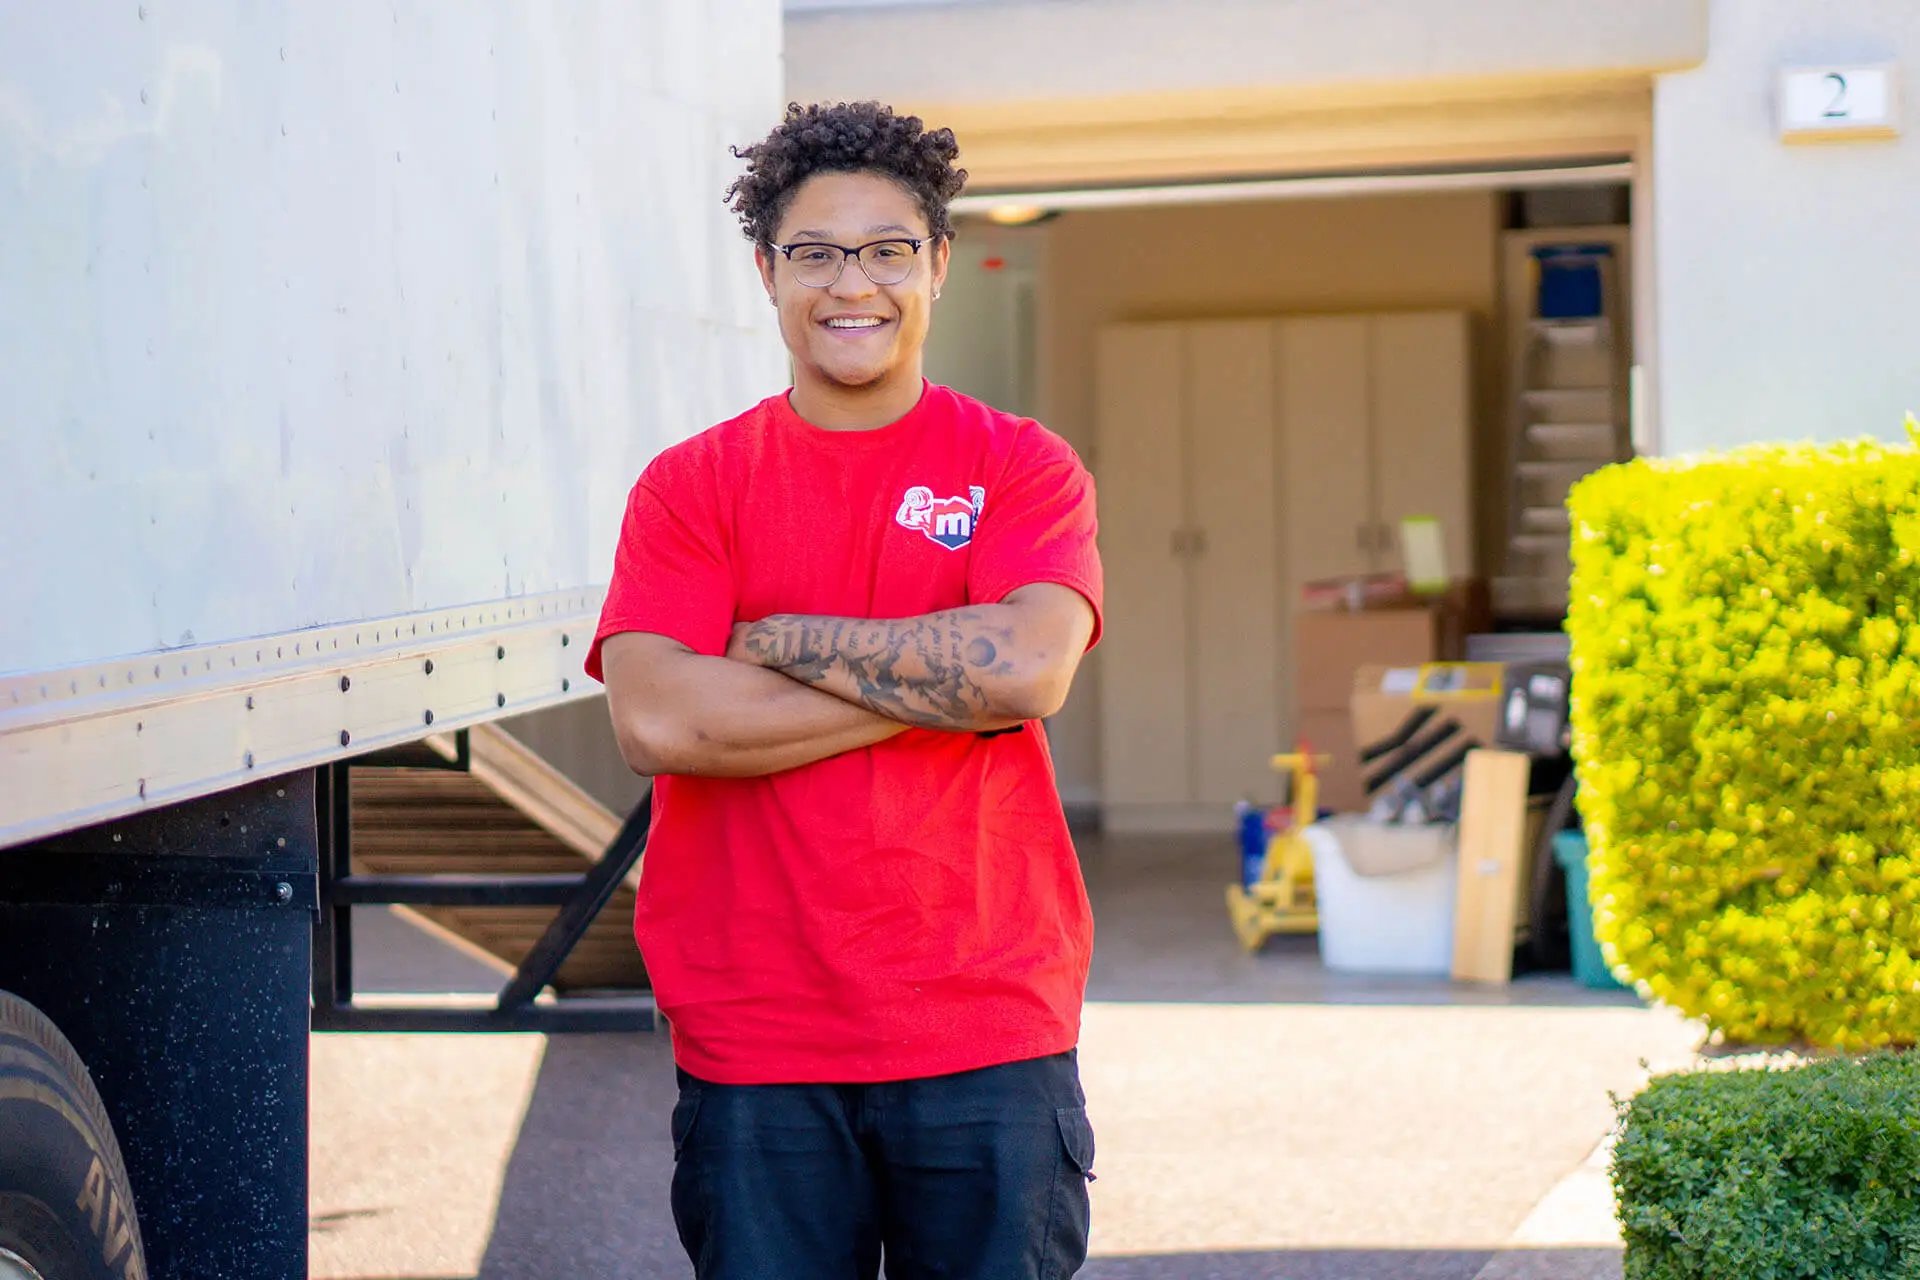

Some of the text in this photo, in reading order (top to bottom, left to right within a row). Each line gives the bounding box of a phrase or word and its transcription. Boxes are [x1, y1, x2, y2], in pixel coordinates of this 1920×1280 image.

[1820, 72, 1849, 118] 2
[935, 511, 970, 537] m
[75, 1153, 143, 1280] AV
